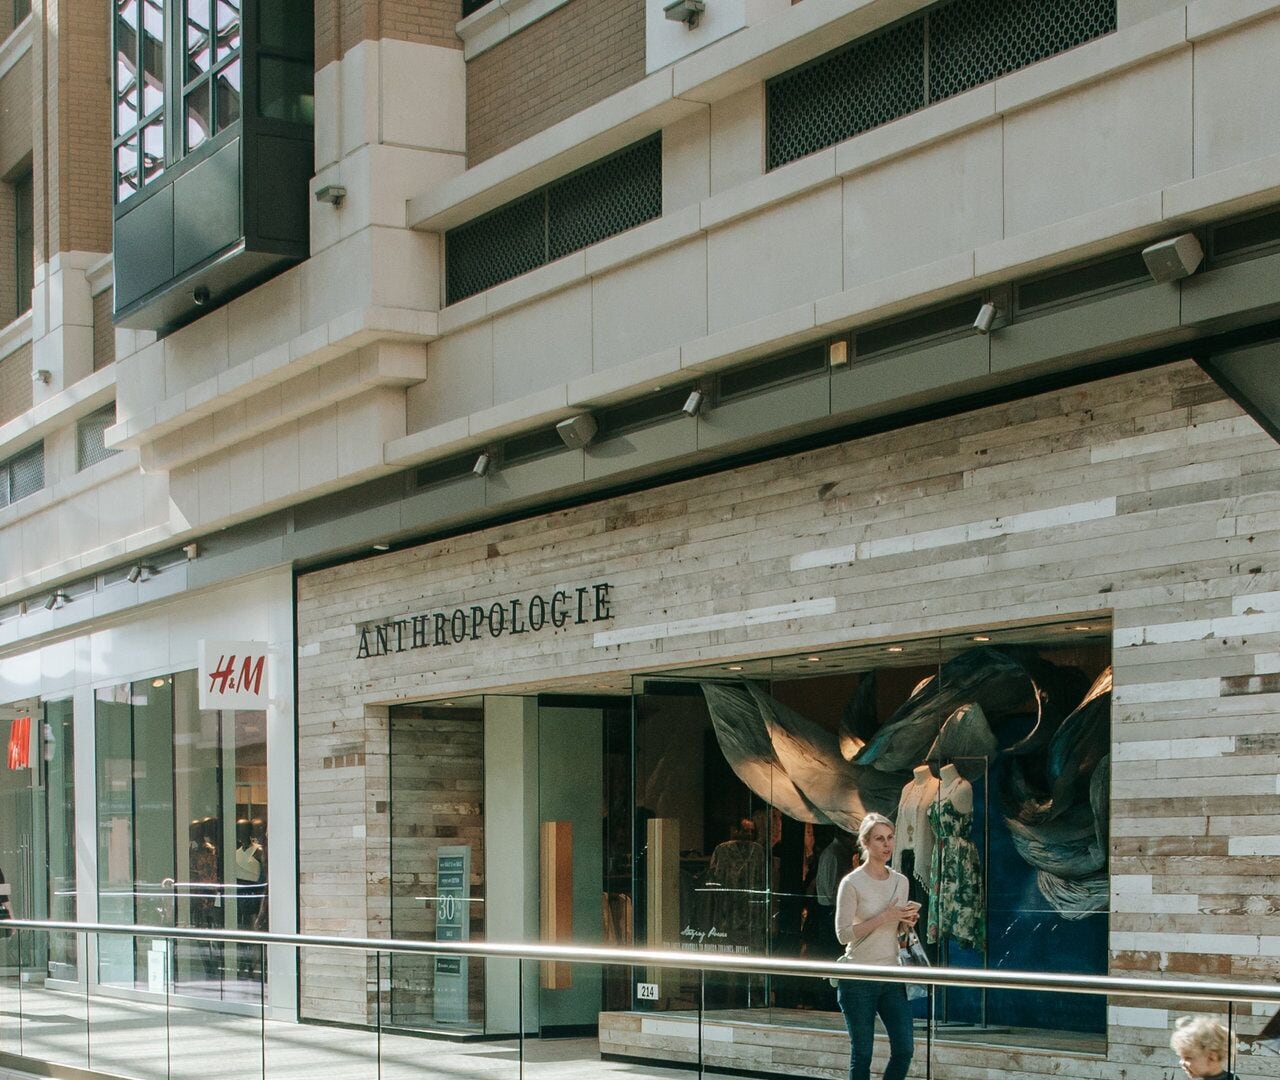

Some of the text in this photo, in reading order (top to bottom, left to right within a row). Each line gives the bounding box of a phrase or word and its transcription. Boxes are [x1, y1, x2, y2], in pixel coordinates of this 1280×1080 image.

[357, 583, 614, 659] ANTHROPOLOGIE
[209, 654, 265, 696] H&M
[641, 986, 654, 997] 214
